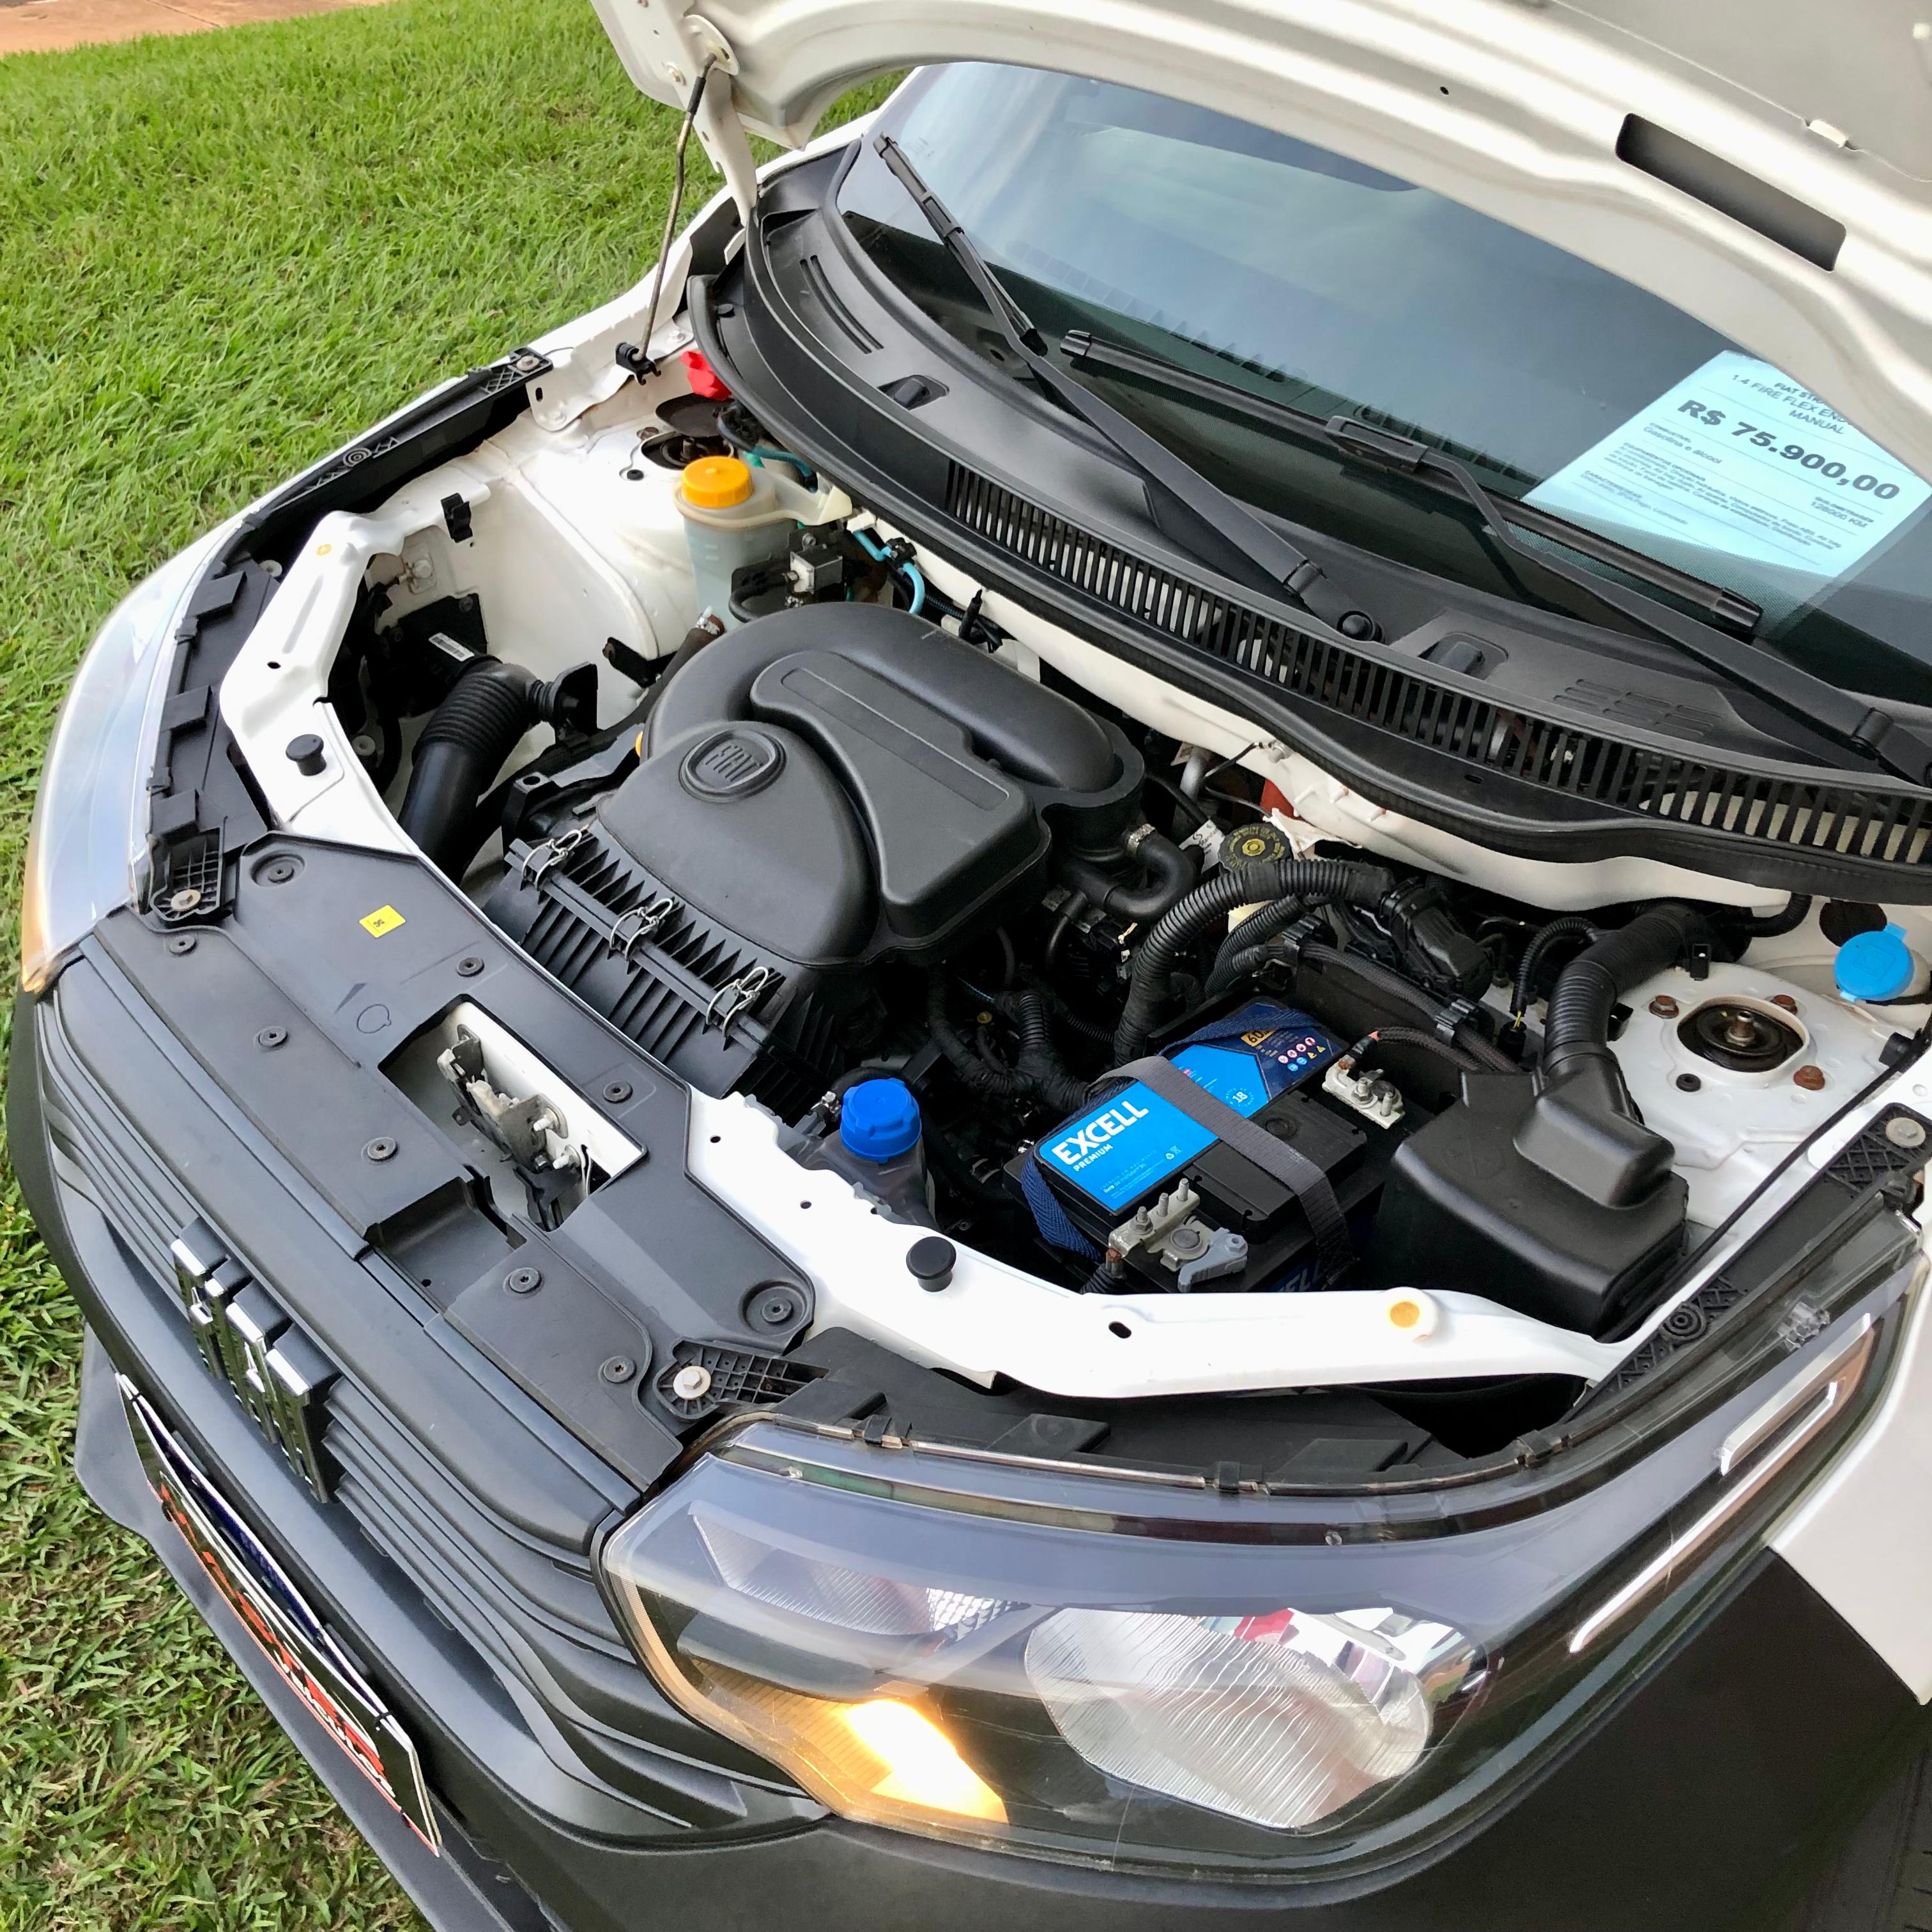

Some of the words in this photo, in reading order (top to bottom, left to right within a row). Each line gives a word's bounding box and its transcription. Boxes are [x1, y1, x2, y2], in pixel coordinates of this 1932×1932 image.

[1731, 374, 1750, 384] 1.4
[1751, 383, 1783, 399] FIRE
[1782, 395, 1818, 412] FLEX
[1774, 383, 1799, 394] FIAT
[1789, 410, 1844, 434] MANUAL
[1677, 399, 1726, 425] R$
[1730, 421, 1900, 500] 75.900,00
[705, 745, 763, 783] FIAT
[1232, 1091, 1248, 1103] 18
[1051, 1100, 1149, 1165] EXCELL
[1073, 1143, 1114, 1172] PREMIUM
